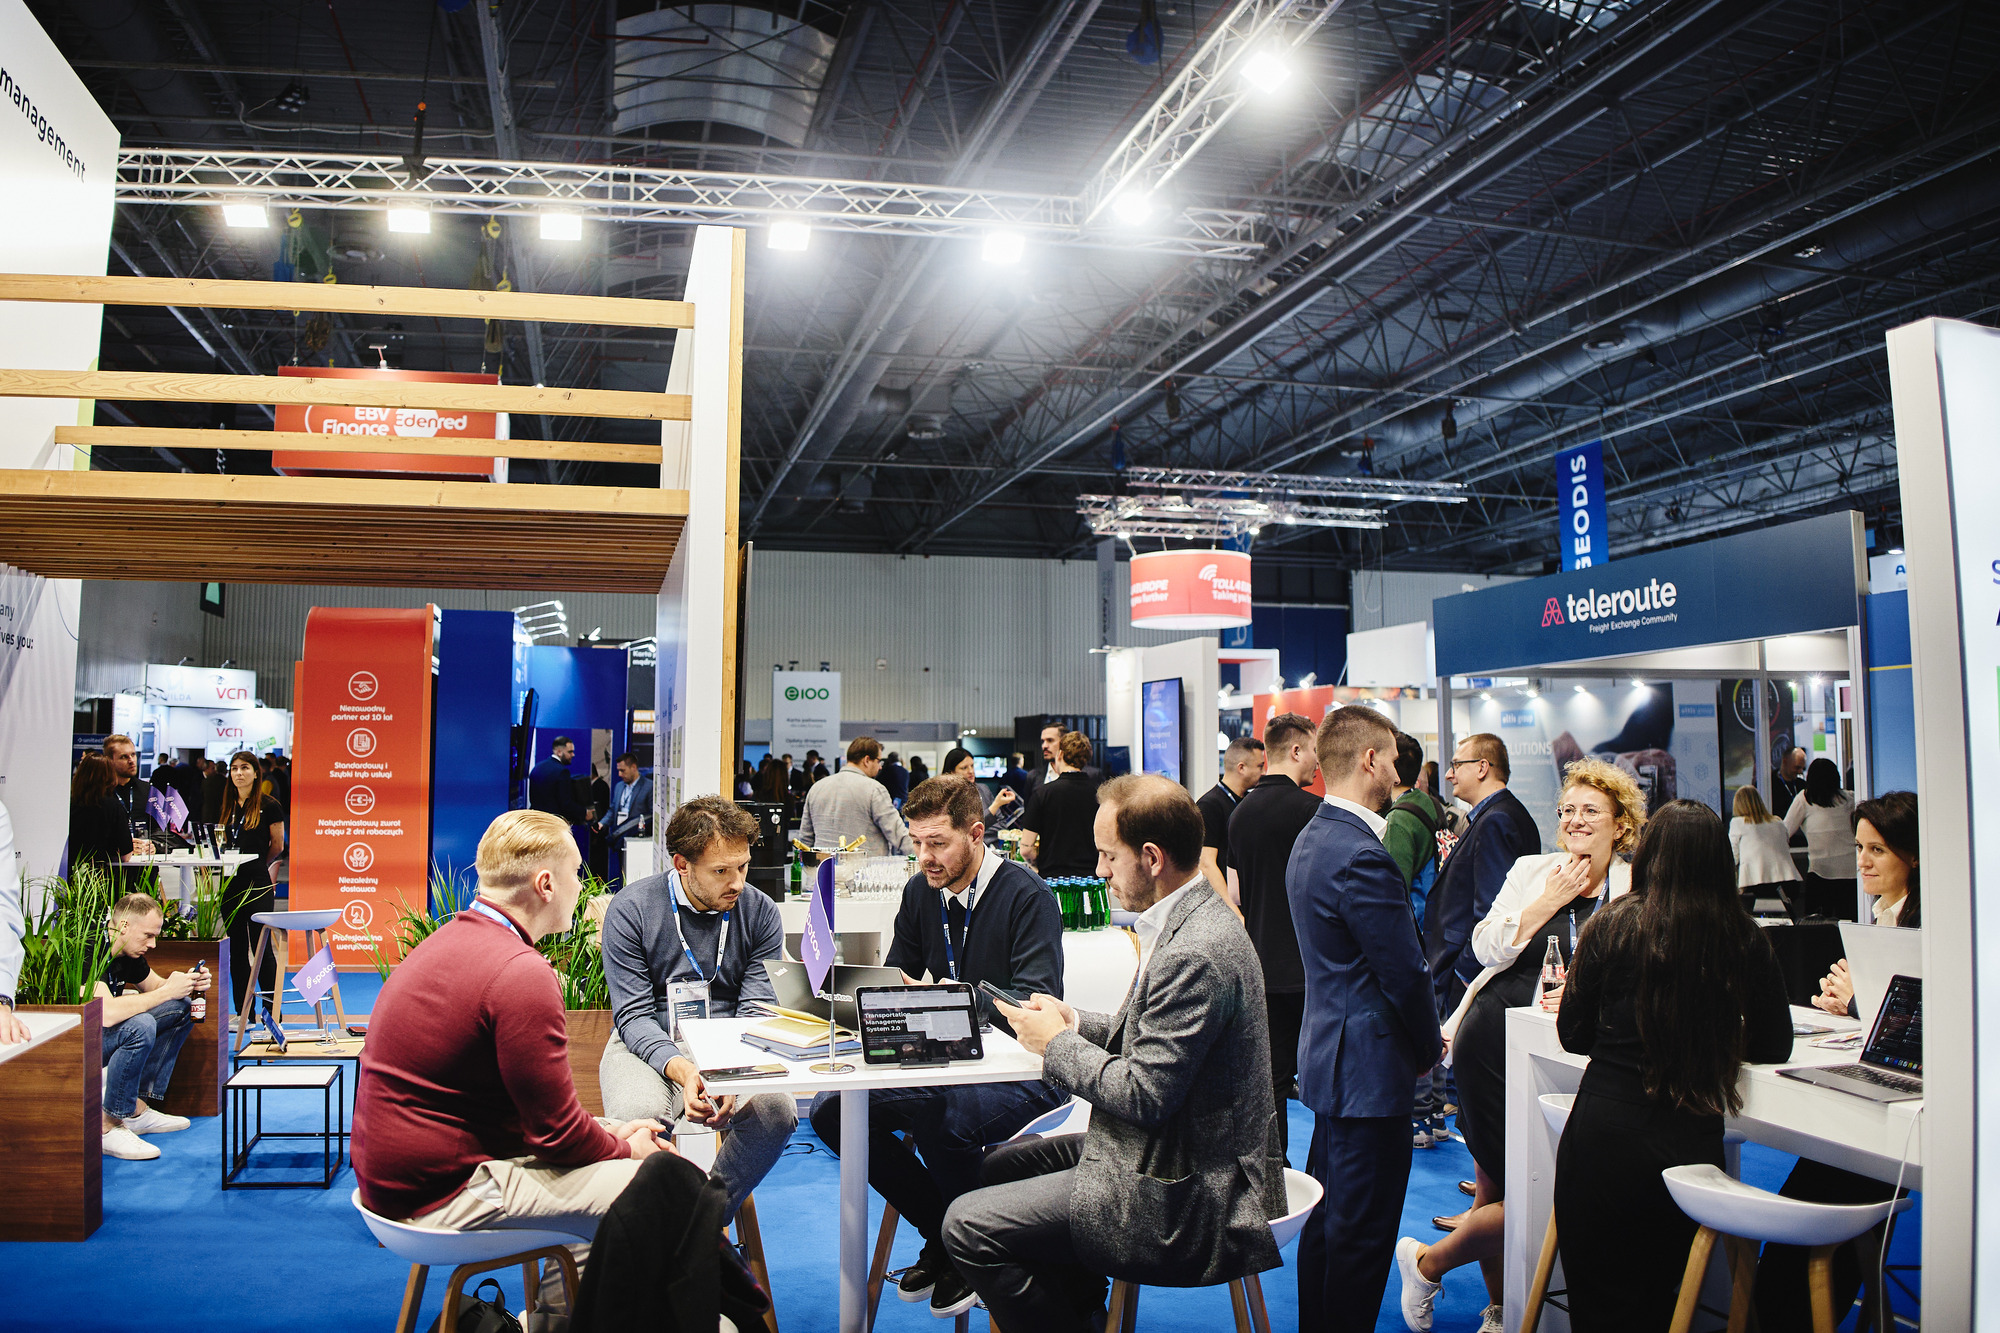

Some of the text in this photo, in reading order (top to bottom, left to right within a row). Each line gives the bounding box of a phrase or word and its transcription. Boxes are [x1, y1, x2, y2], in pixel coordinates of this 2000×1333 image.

[0, 67, 85, 183] management
[355, 407, 390, 422] EBV
[396, 413, 468, 431] Edenred
[323, 419, 390, 436] Finance
[1567, 578, 1677, 623] teleroute
[1590, 613, 1678, 634] Freight Exchange Community
[0, 630, 34, 650] ves you:
[340, 705, 386, 713] Niezawodny
[332, 714, 358, 722] partner
[330, 771, 353, 779] Szybki
[355, 771, 370, 779] tryb
[335, 762, 384, 771] Standardowy
[319, 819, 379, 828] Natychmiastowy
[353, 828, 366, 836] dni
[367, 828, 404, 837] roboczych
[806, 913, 821, 961] potos
[313, 961, 336, 985] spotos
